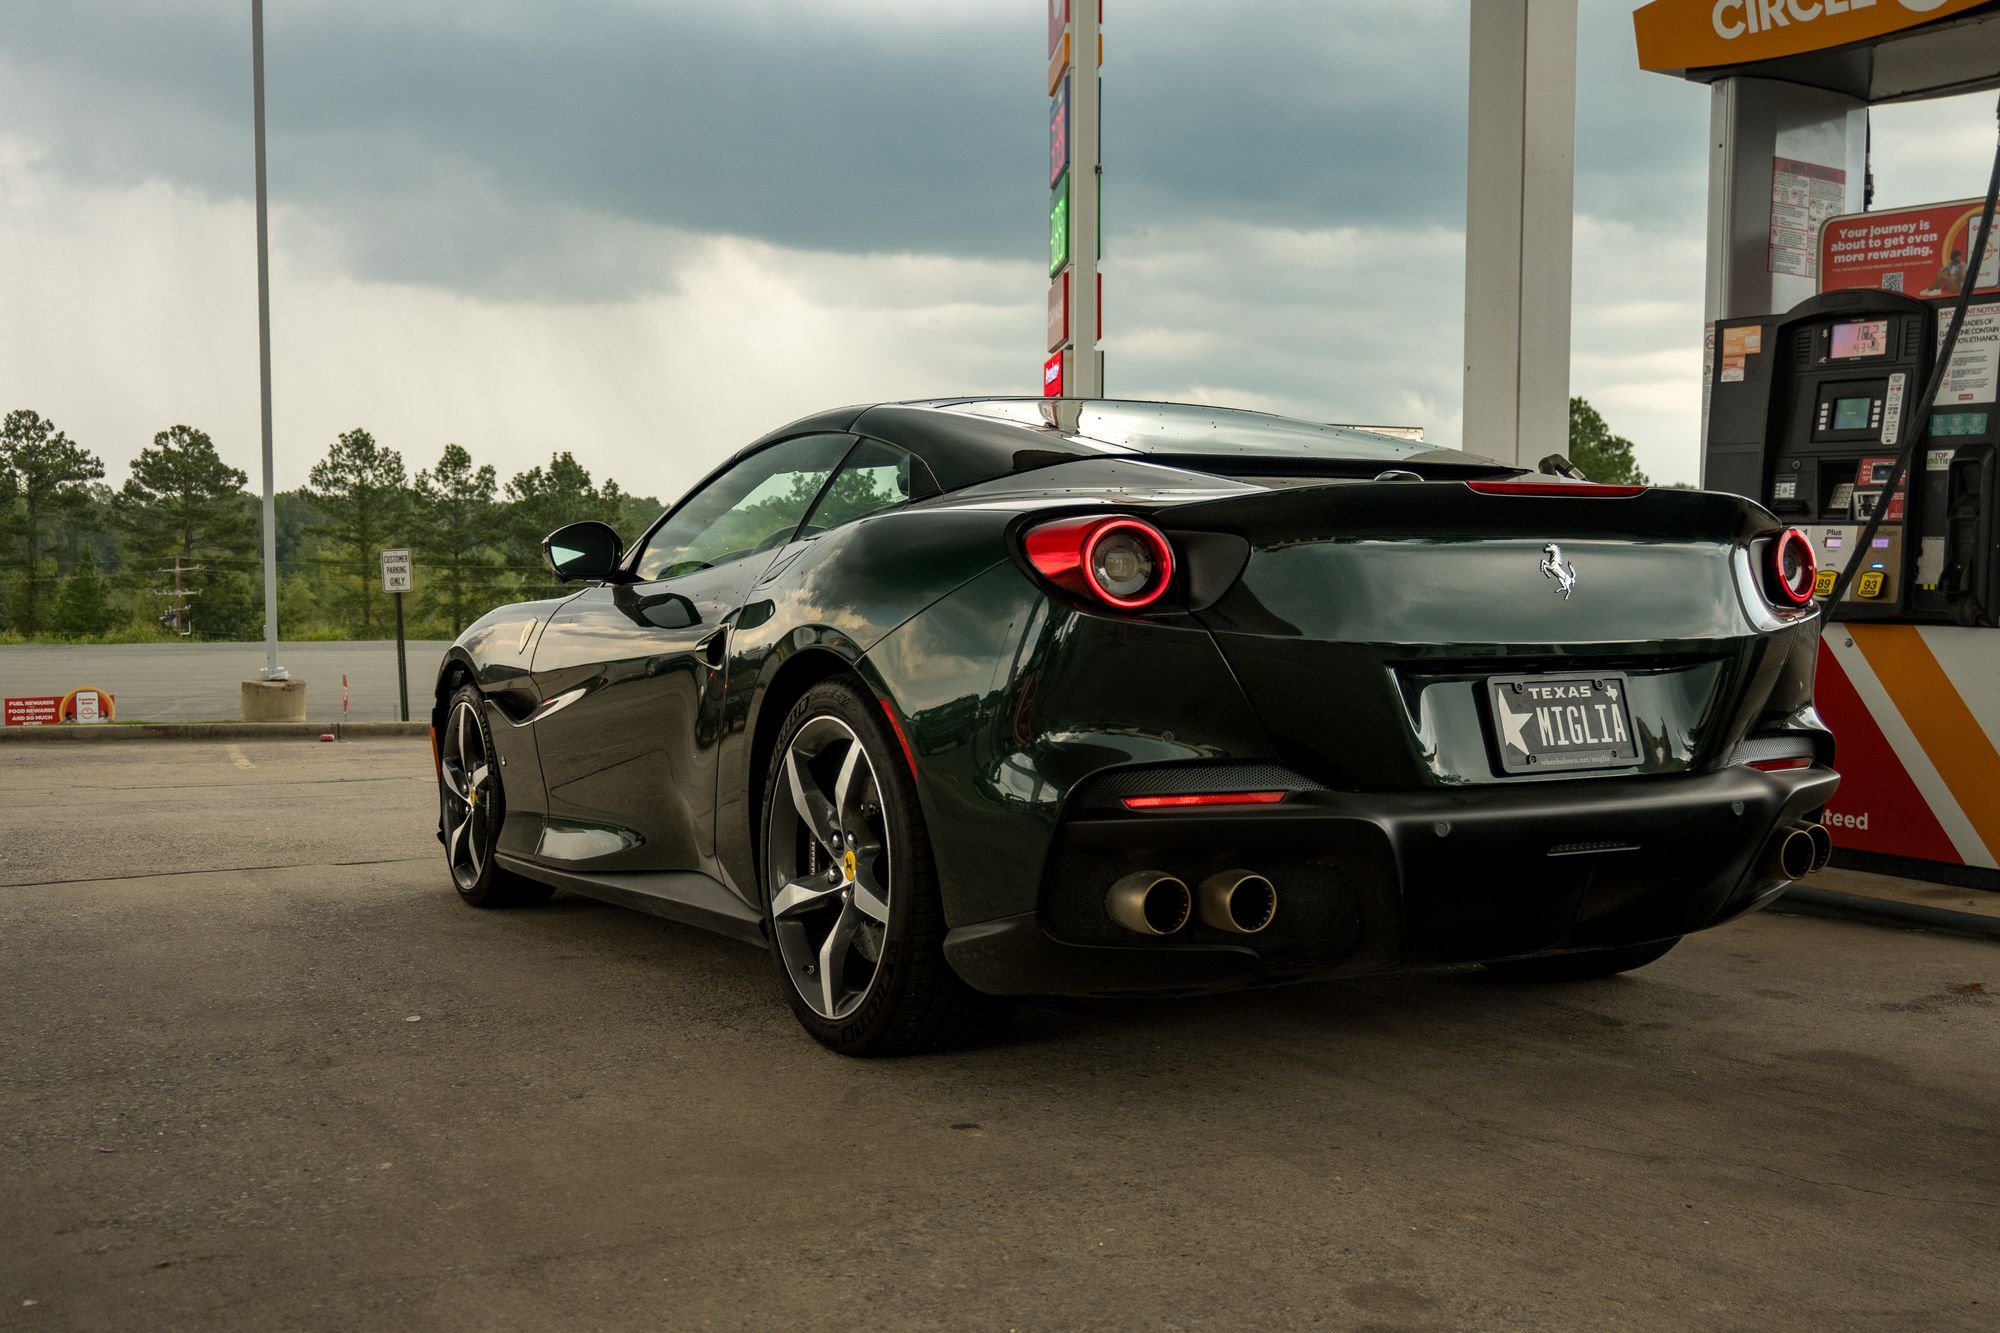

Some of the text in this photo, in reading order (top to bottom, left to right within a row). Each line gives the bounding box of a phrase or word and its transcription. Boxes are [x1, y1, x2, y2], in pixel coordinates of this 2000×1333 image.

[1712, 0, 1876, 40] CIRCL
[1839, 220, 1930, 239] Your journey is
[1831, 232, 1938, 252] about to get even
[1833, 246, 1933, 264] more rewarding.
[384, 555, 408, 563] CUSTOMER
[386, 566, 407, 574] PARKING
[1817, 579, 1831, 589] 89
[1863, 580, 1878, 590] 93
[1528, 686, 1592, 699] TEXAS
[1536, 703, 1628, 747] MIGLIA
